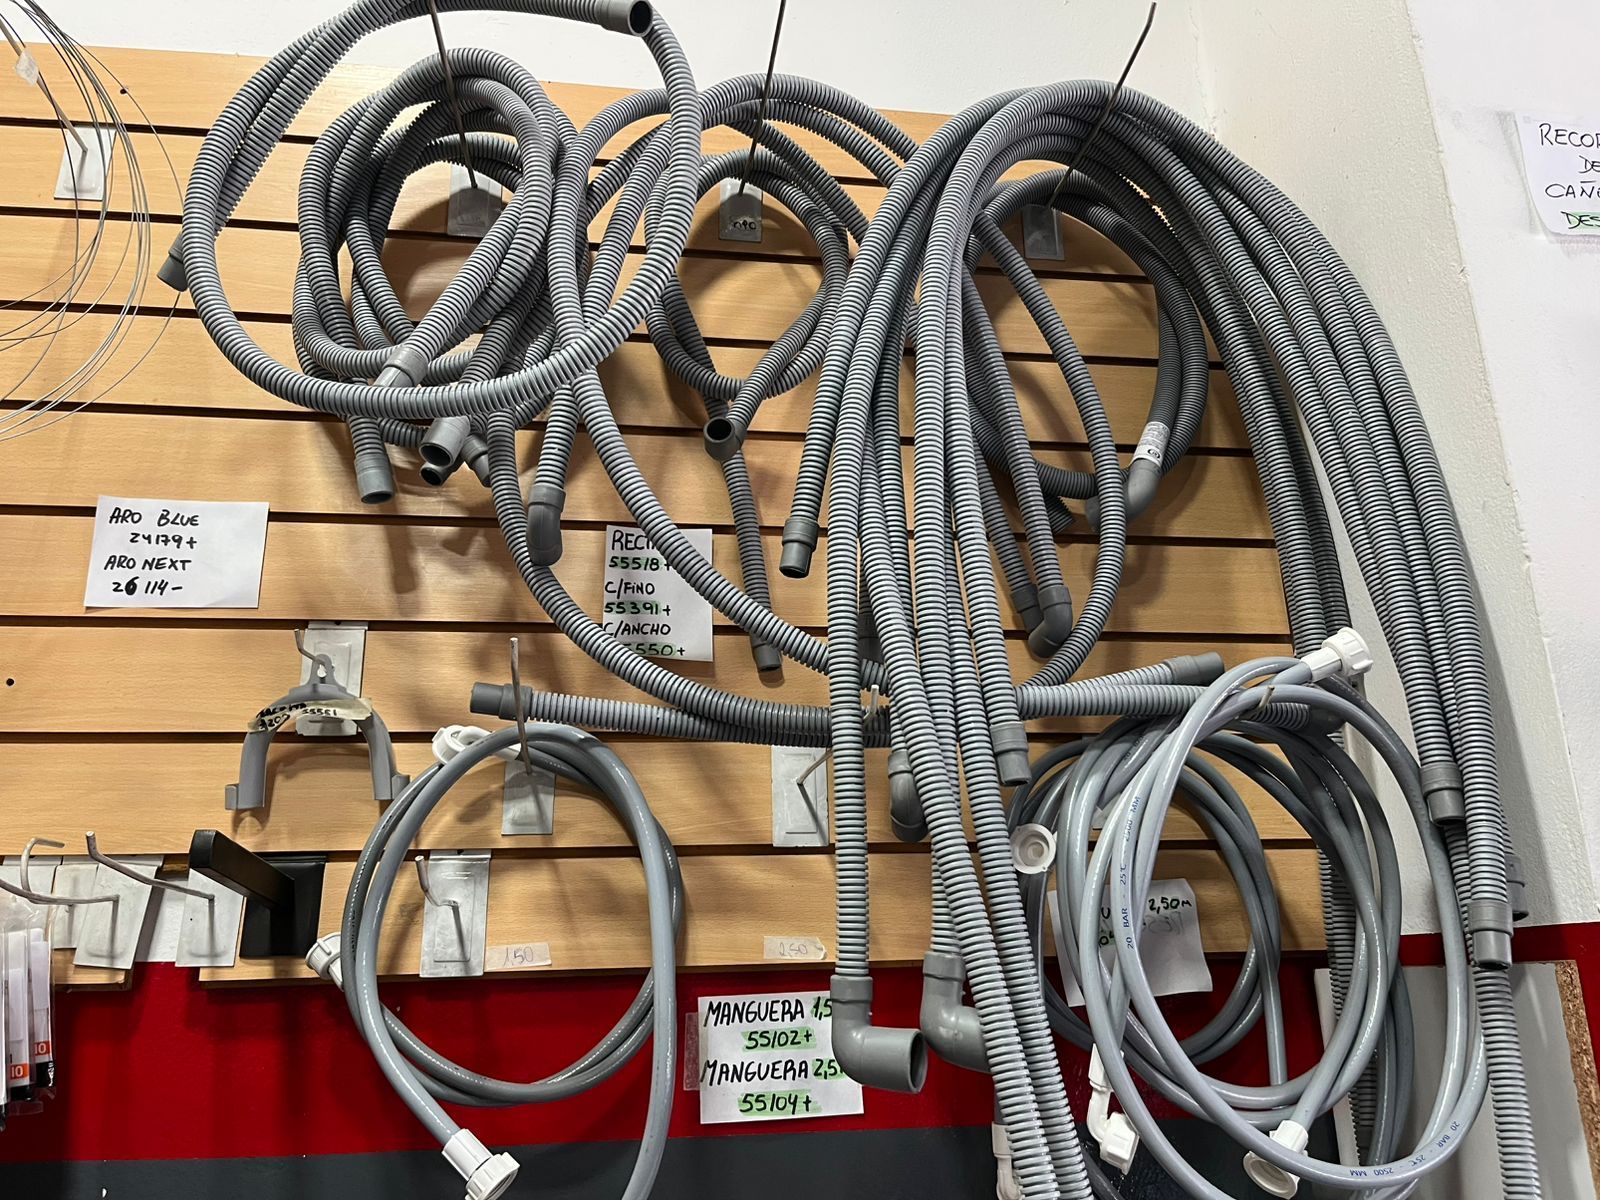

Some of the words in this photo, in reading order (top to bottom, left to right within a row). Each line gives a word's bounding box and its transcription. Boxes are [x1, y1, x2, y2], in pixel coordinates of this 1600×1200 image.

[109, 507, 142, 524] ARO
[157, 509, 200, 527] BLUE
[104, 555, 136, 570] ARO
[141, 557, 192, 571] NEXT
[603, 620, 671, 638] C/ANCHO
[1121, 908, 1130, 927] BAR
[1126, 936, 1134, 949] 20
[703, 999, 805, 1027] MANGUERA
[11, 1065, 24, 1078] 10
[700, 1059, 809, 1087] MANGUERA
[813, 1058, 844, 1080] 2,5
[1437, 1134, 1450, 1148] BAR
[1350, 1169, 1367, 1177] MM
[1373, 1167, 1394, 1176] 2500
